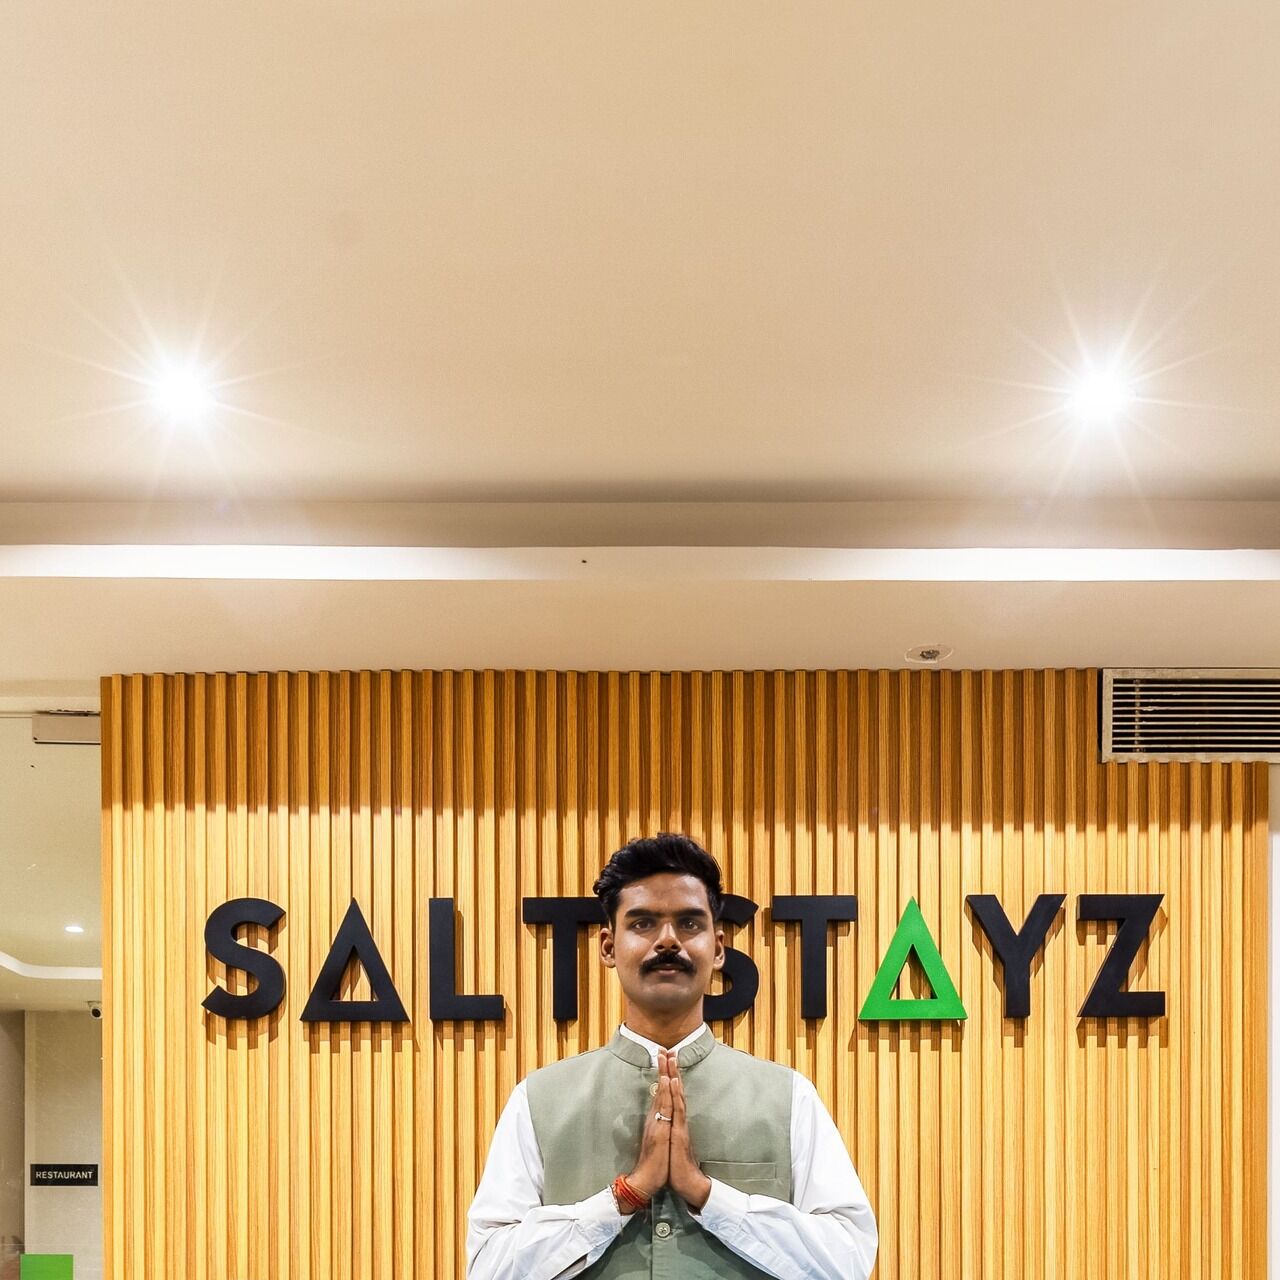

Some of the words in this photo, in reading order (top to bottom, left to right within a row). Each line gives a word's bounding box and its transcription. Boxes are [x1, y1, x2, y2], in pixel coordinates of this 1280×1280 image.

[201, 896, 609, 1022] SALT
[703, 893, 1166, 1021] STAYZ
[35, 1171, 93, 1179] RESTAURANT
